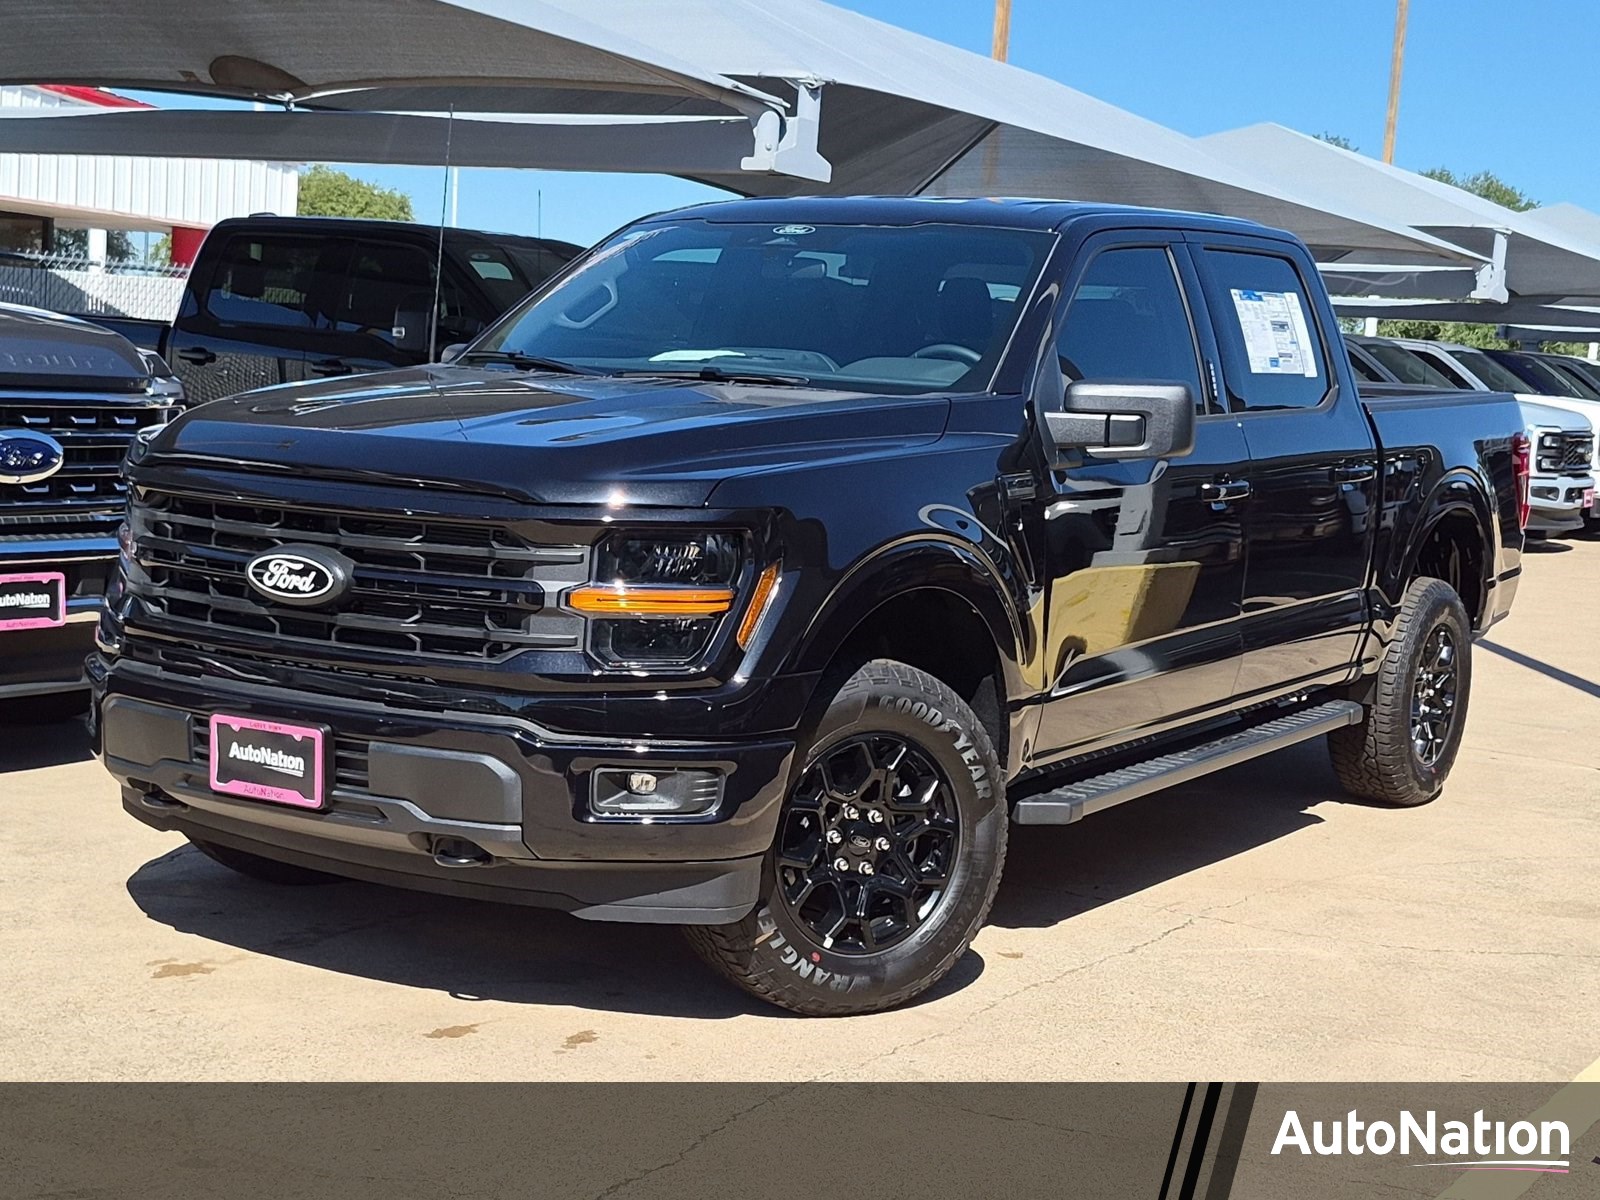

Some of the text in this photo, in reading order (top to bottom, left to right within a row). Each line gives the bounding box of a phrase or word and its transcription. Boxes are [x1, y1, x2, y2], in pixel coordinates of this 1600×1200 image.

[262, 559, 317, 592] Ford
[0, 592, 50, 606] utoNation
[228, 741, 305, 771] AutoNation
